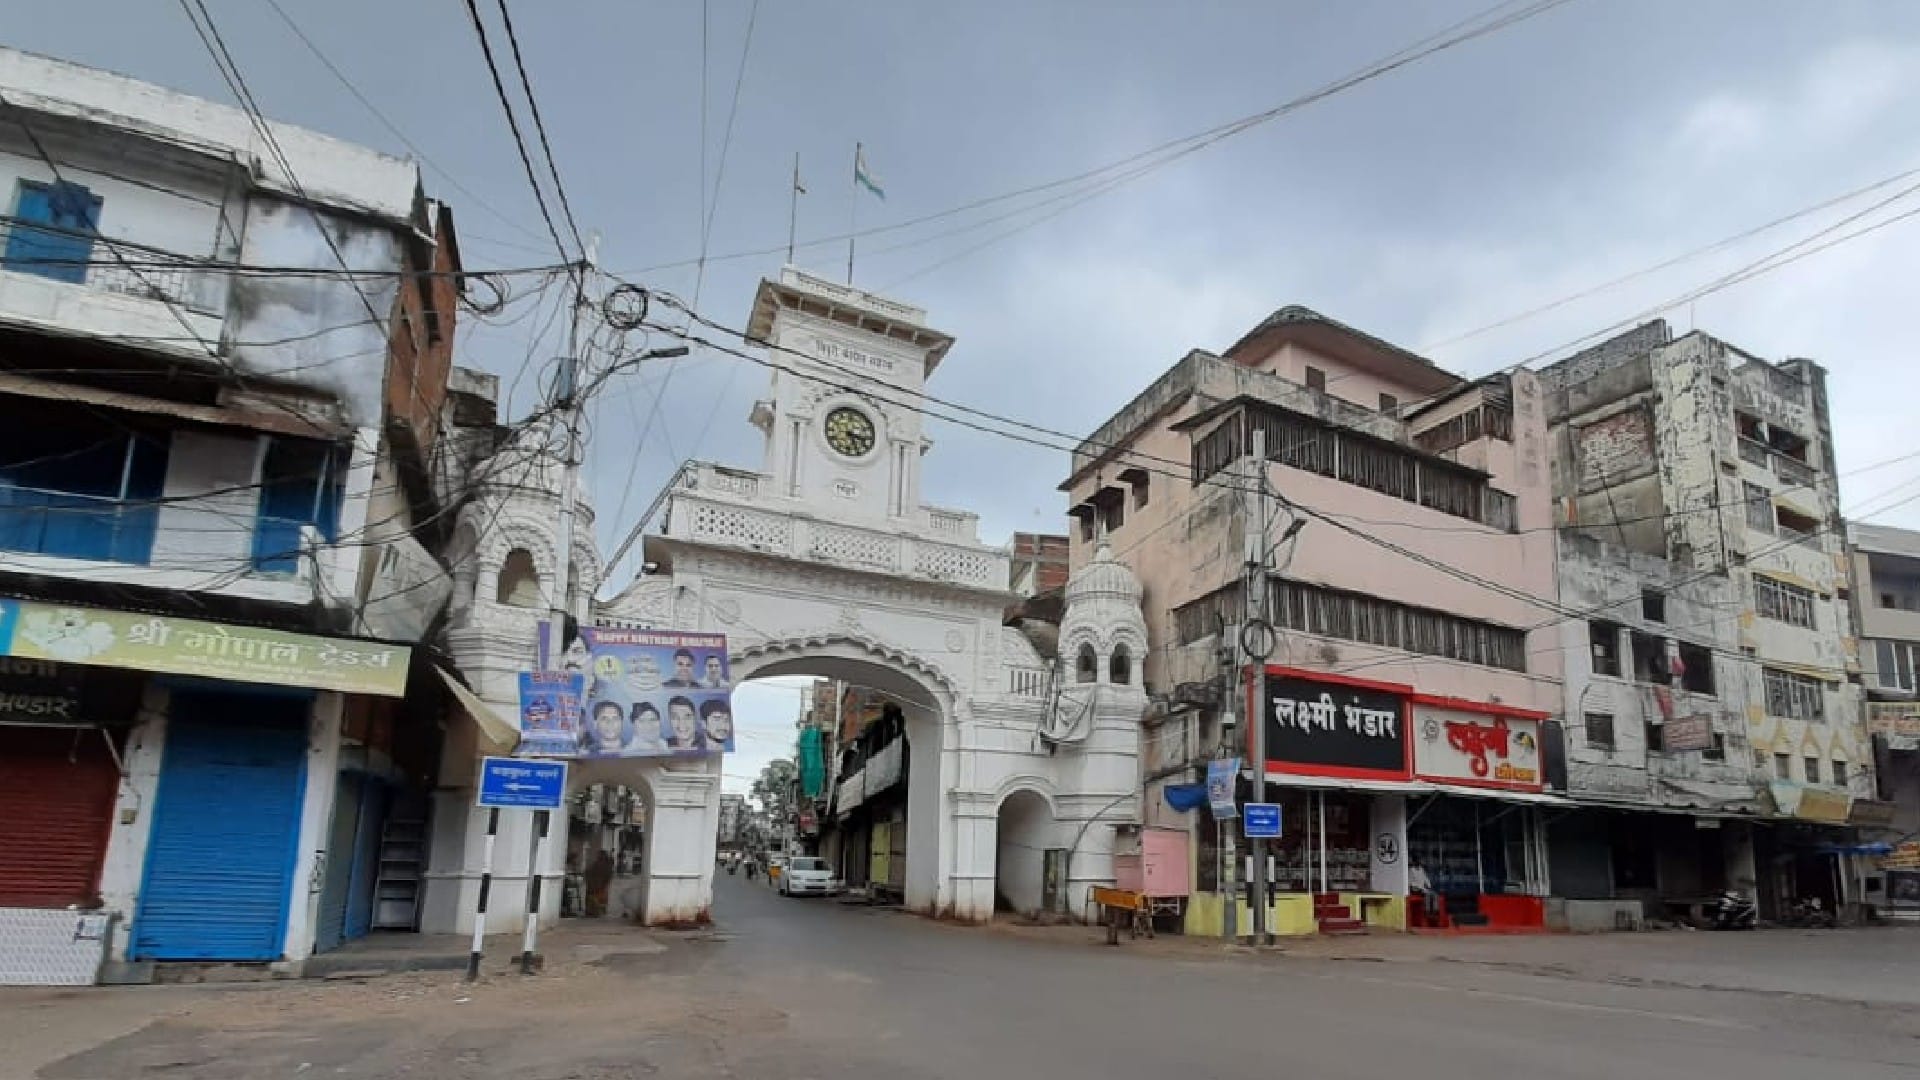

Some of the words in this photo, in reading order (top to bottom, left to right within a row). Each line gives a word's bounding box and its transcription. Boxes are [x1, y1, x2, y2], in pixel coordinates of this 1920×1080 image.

[127, 617, 172, 648] श्री
[179, 626, 305, 664] गोपाल
[1272, 692, 1337, 734] लक्ष्मी
[1343, 697, 1398, 739] भंडार
